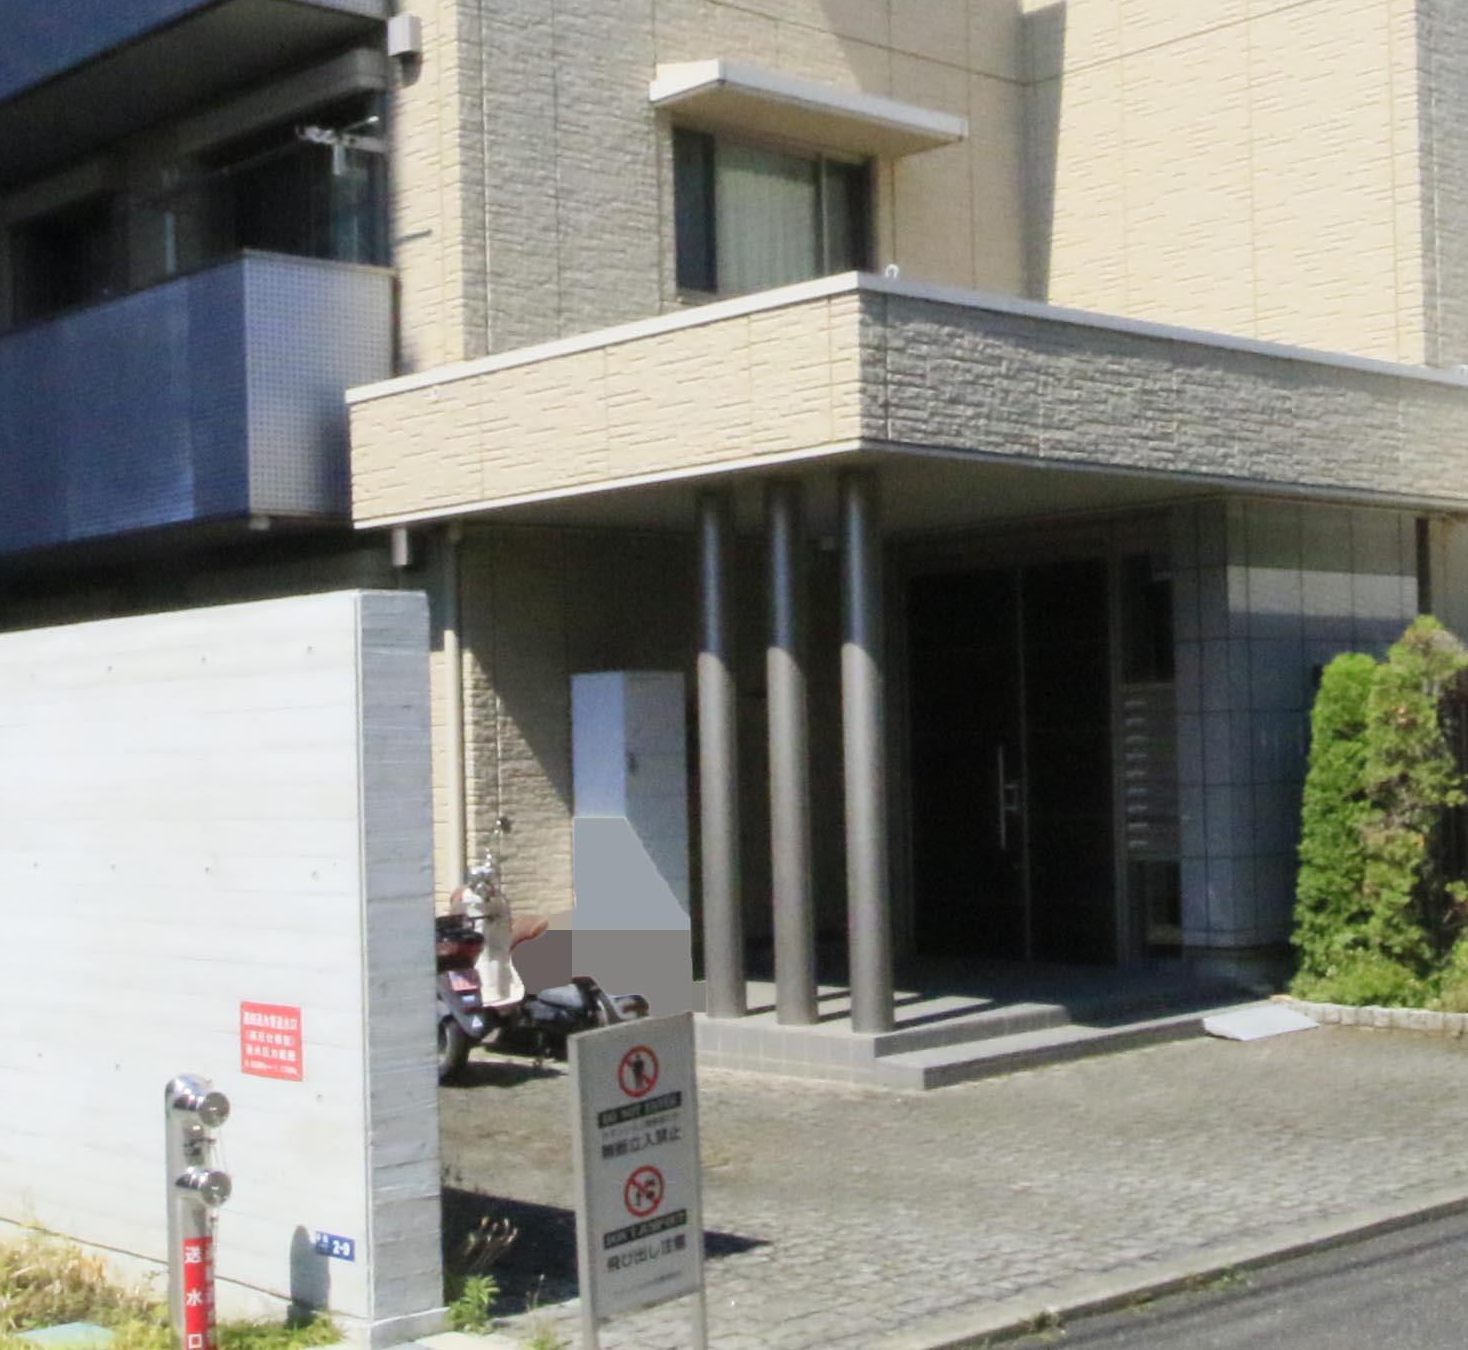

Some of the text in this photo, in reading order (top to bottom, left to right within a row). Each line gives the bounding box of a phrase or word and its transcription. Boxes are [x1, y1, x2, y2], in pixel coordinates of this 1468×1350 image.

[607, 1233, 686, 1272] 飛び出し注意
[184, 1245, 203, 1349] 送水口
